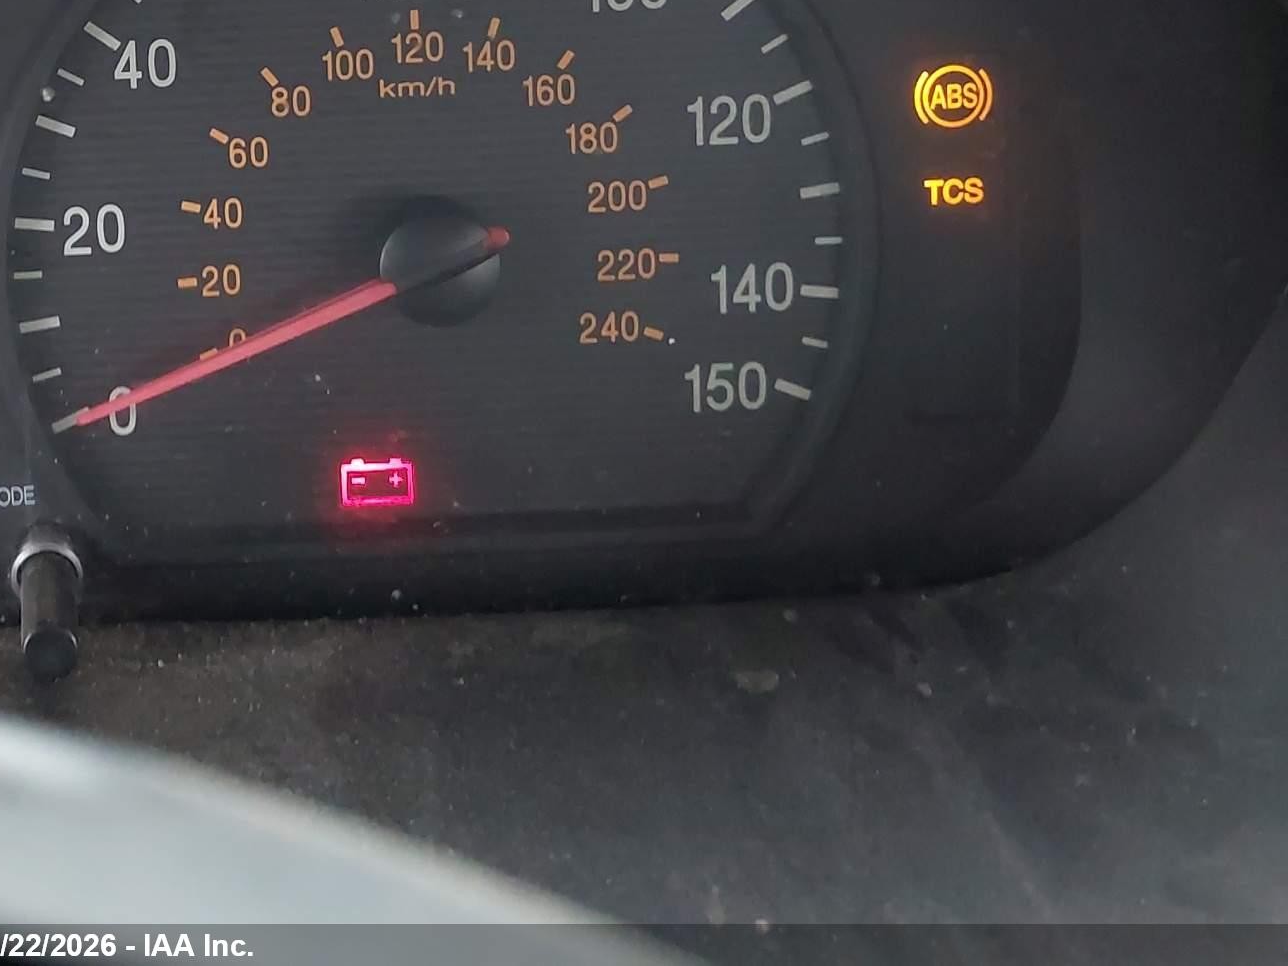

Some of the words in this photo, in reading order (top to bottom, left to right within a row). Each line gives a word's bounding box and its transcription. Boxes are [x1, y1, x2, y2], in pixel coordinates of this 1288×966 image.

[113, 37, 178, 90] 40
[321, 48, 375, 82] 100
[391, 31, 445, 65] 120
[462, 39, 516, 73] 140
[270, 85, 312, 118] 80
[378, 75, 456, 100] km/h
[522, 73, 576, 107] 160
[930, 86, 979, 110] ABS
[686, 93, 773, 147] 120
[228, 136, 270, 169] 60
[565, 121, 619, 155] 180
[587, 179, 648, 214] 200
[923, 177, 985, 207] TCS
[62, 203, 127, 257] 20
[203, 197, 244, 230] 40
[201, 263, 242, 298] 20
[597, 247, 656, 282] 220
[711, 261, 795, 315] 140
[579, 310, 640, 344] 240
[684, 360, 768, 414] 150
[108, 384, 137, 437] 0
